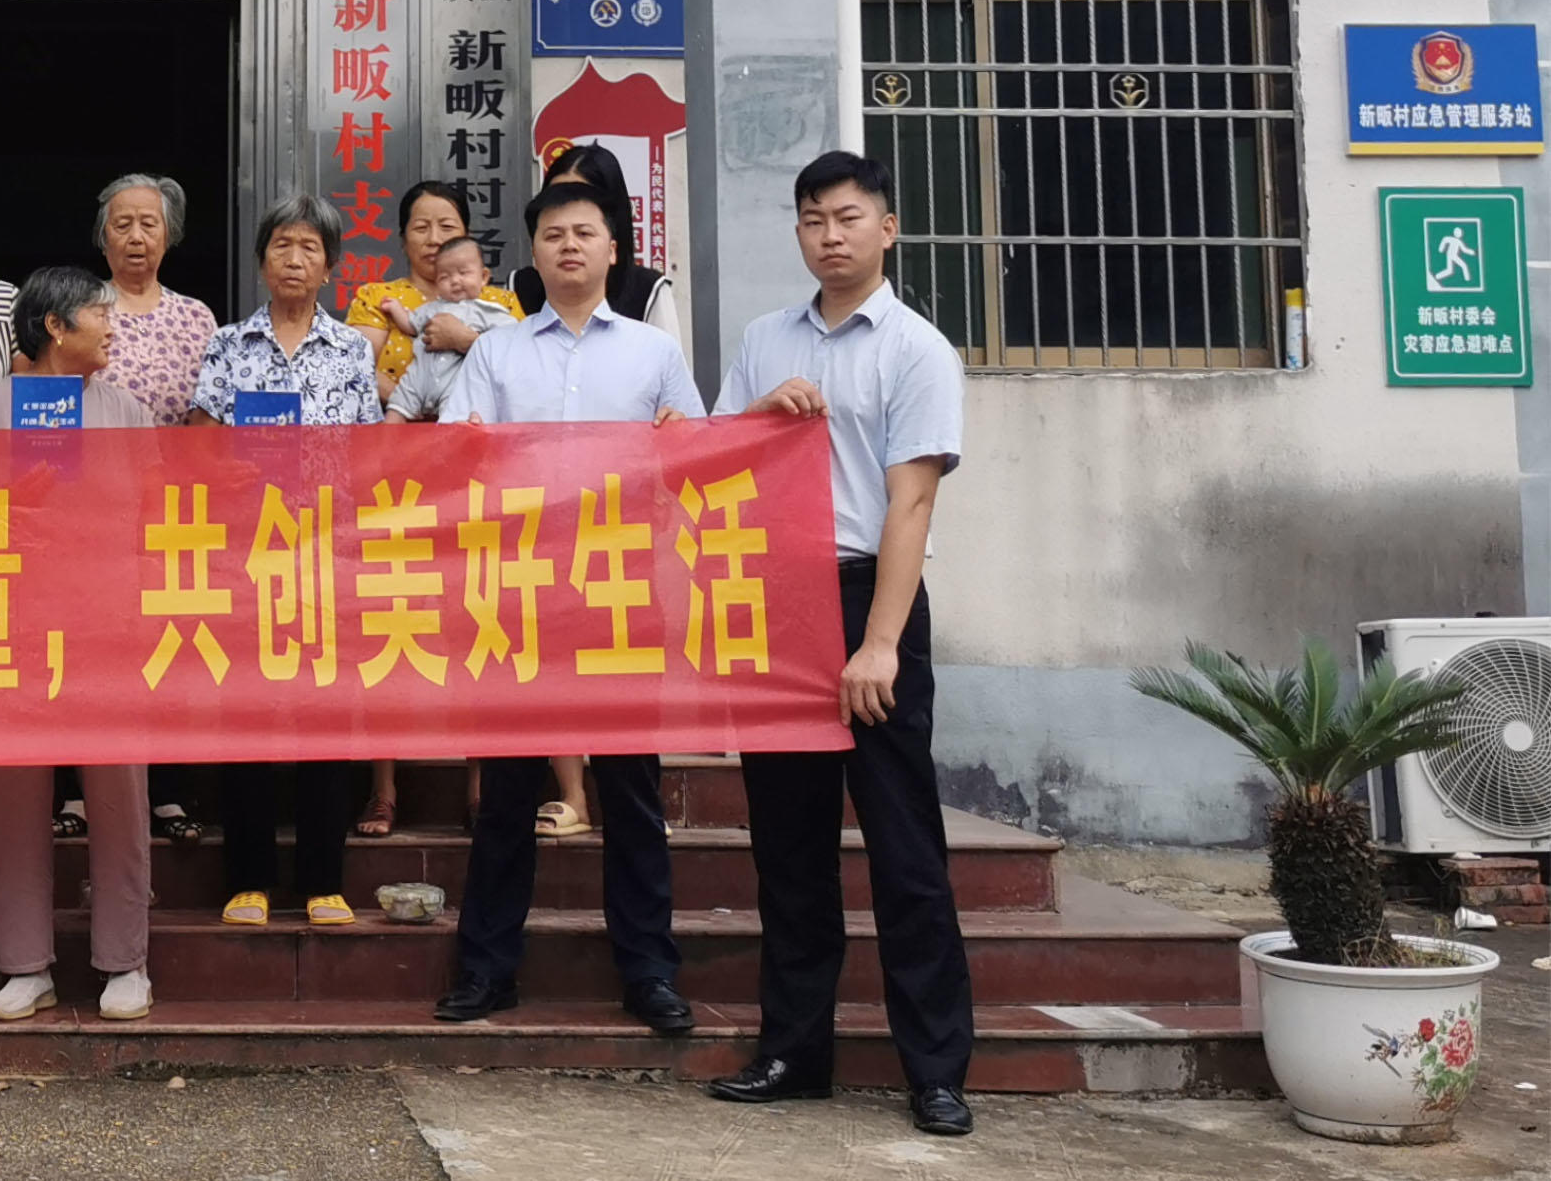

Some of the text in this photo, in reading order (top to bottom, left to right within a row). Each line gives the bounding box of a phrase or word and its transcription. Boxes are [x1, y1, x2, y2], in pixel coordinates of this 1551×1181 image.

[1358, 103, 1533, 129] 新畈村应急管理服务站
[1417, 306, 1497, 327] 新畈村委会
[1402, 333, 1514, 355] 灾害应急避难点
